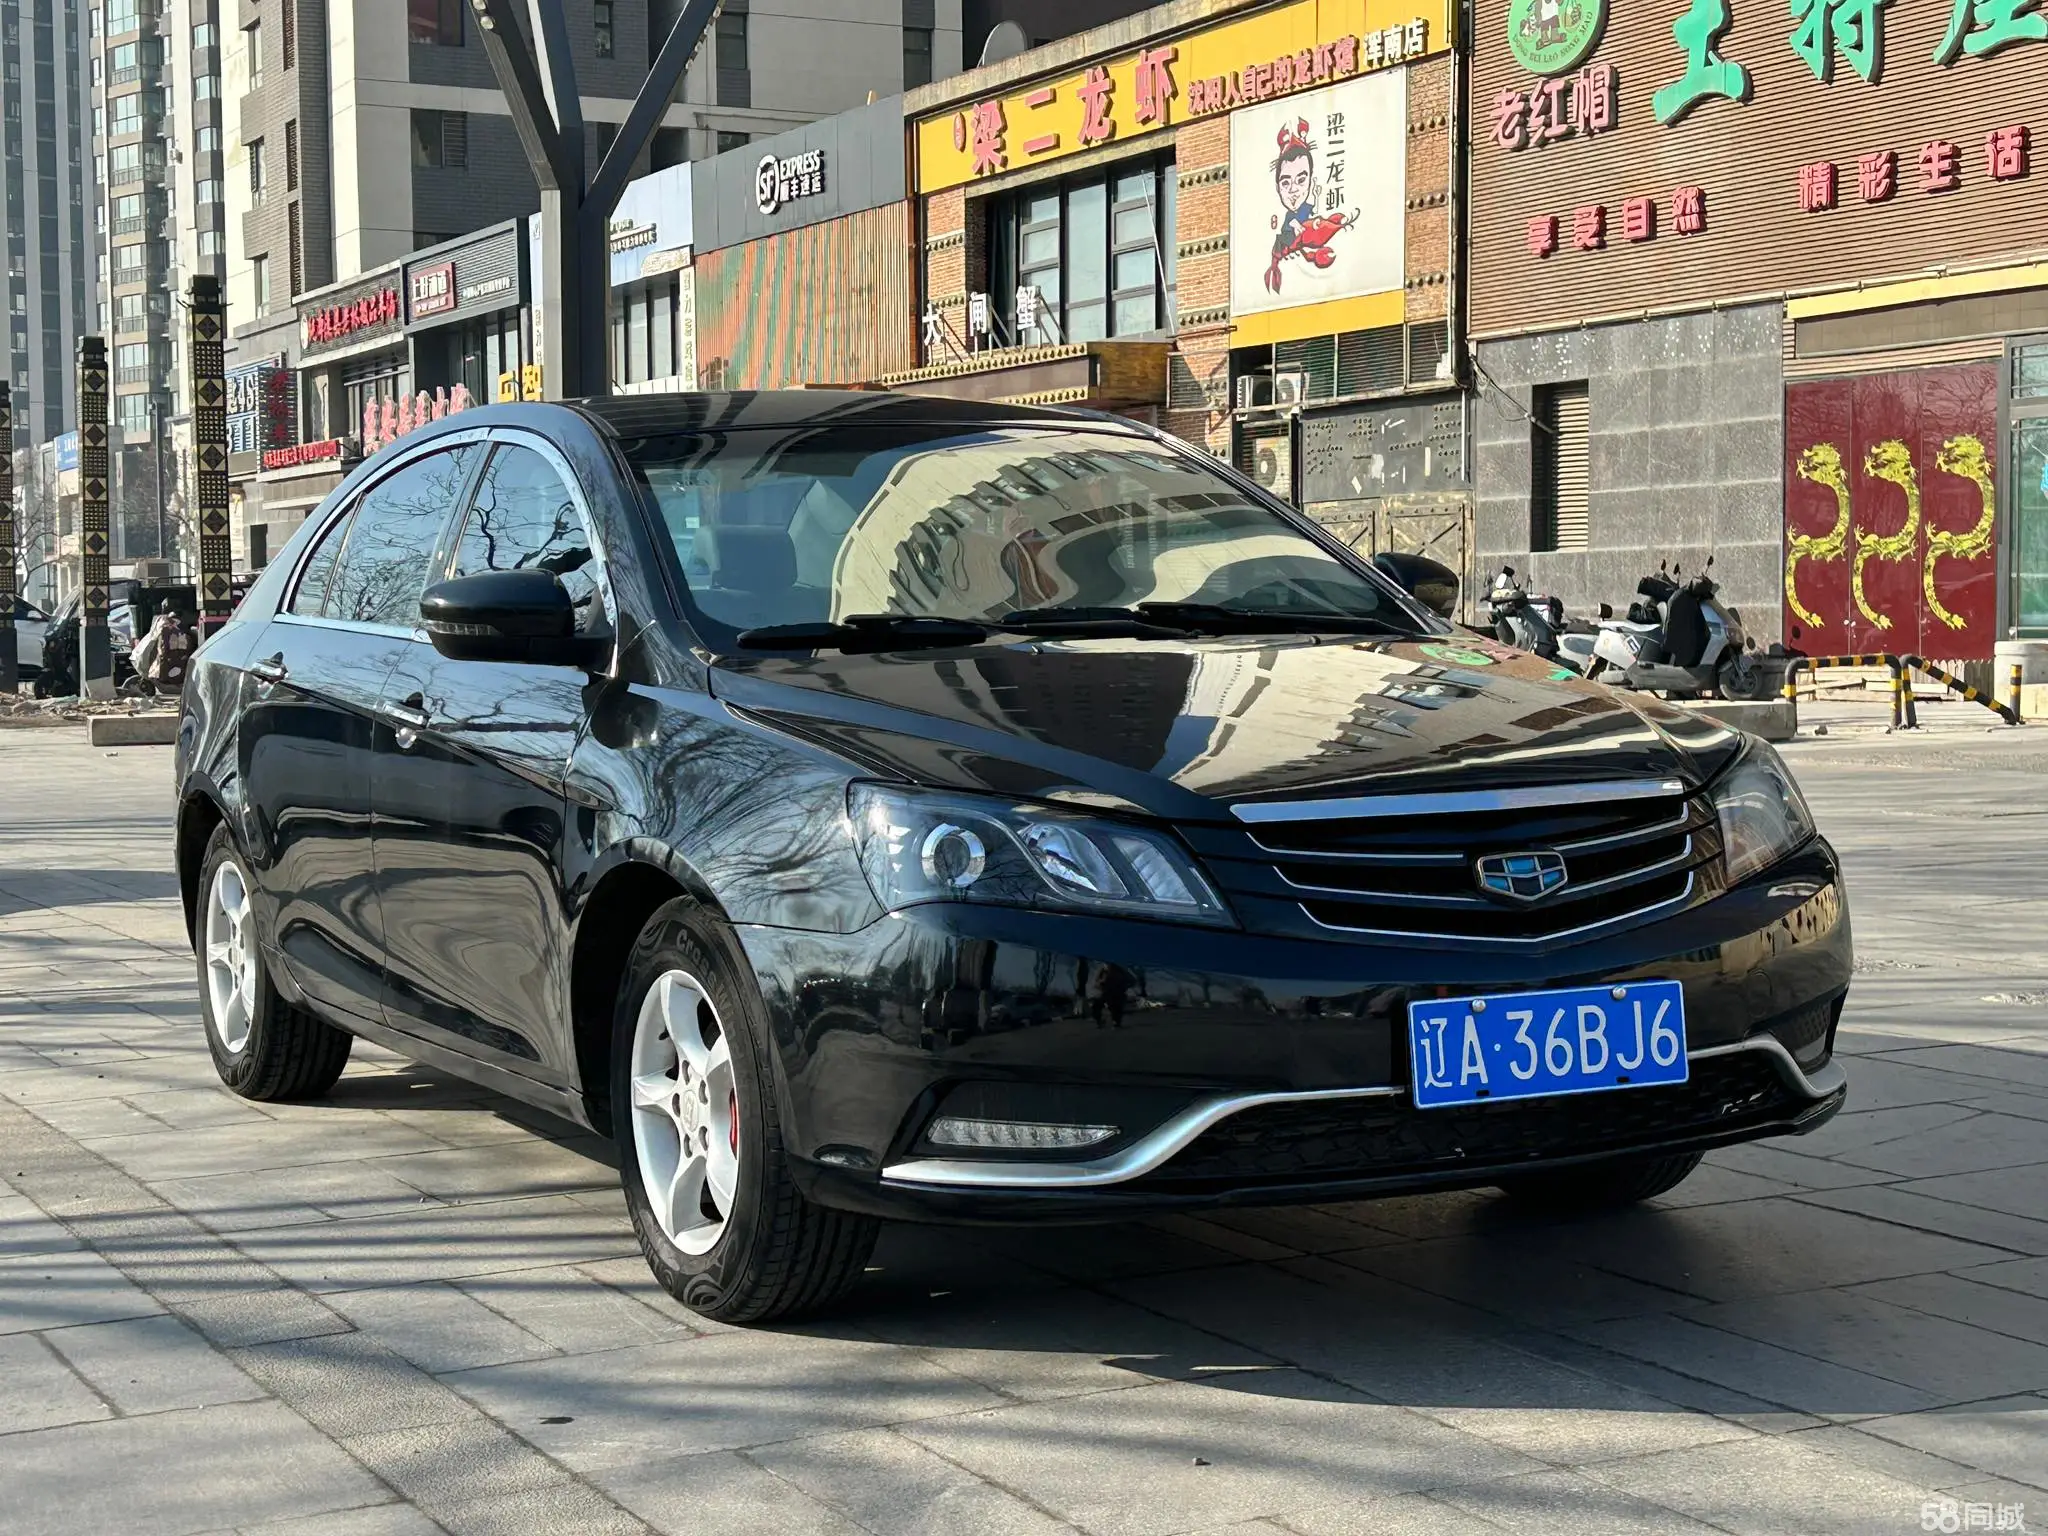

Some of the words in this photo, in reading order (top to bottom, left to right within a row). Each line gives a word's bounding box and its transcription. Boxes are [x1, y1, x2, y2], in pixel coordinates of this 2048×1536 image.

[971, 47, 1178, 175] 梁二龙虾
[1188, 36, 1359, 114] 沈阳人自己的龙虾馆
[1363, 17, 1429, 68] 浑南店
[1488, 64, 1617, 151] 老红帽
[780, 149, 822, 181] EXPRESS
[1326, 112, 1346, 211] 梁二龙虾
[1527, 184, 1707, 258] 享受自然
[1799, 125, 2030, 213] 精彩生活
[922, 286, 1039, 347] 大闸蟹
[1420, 999, 1680, 1089] 辽A·36BJ6
